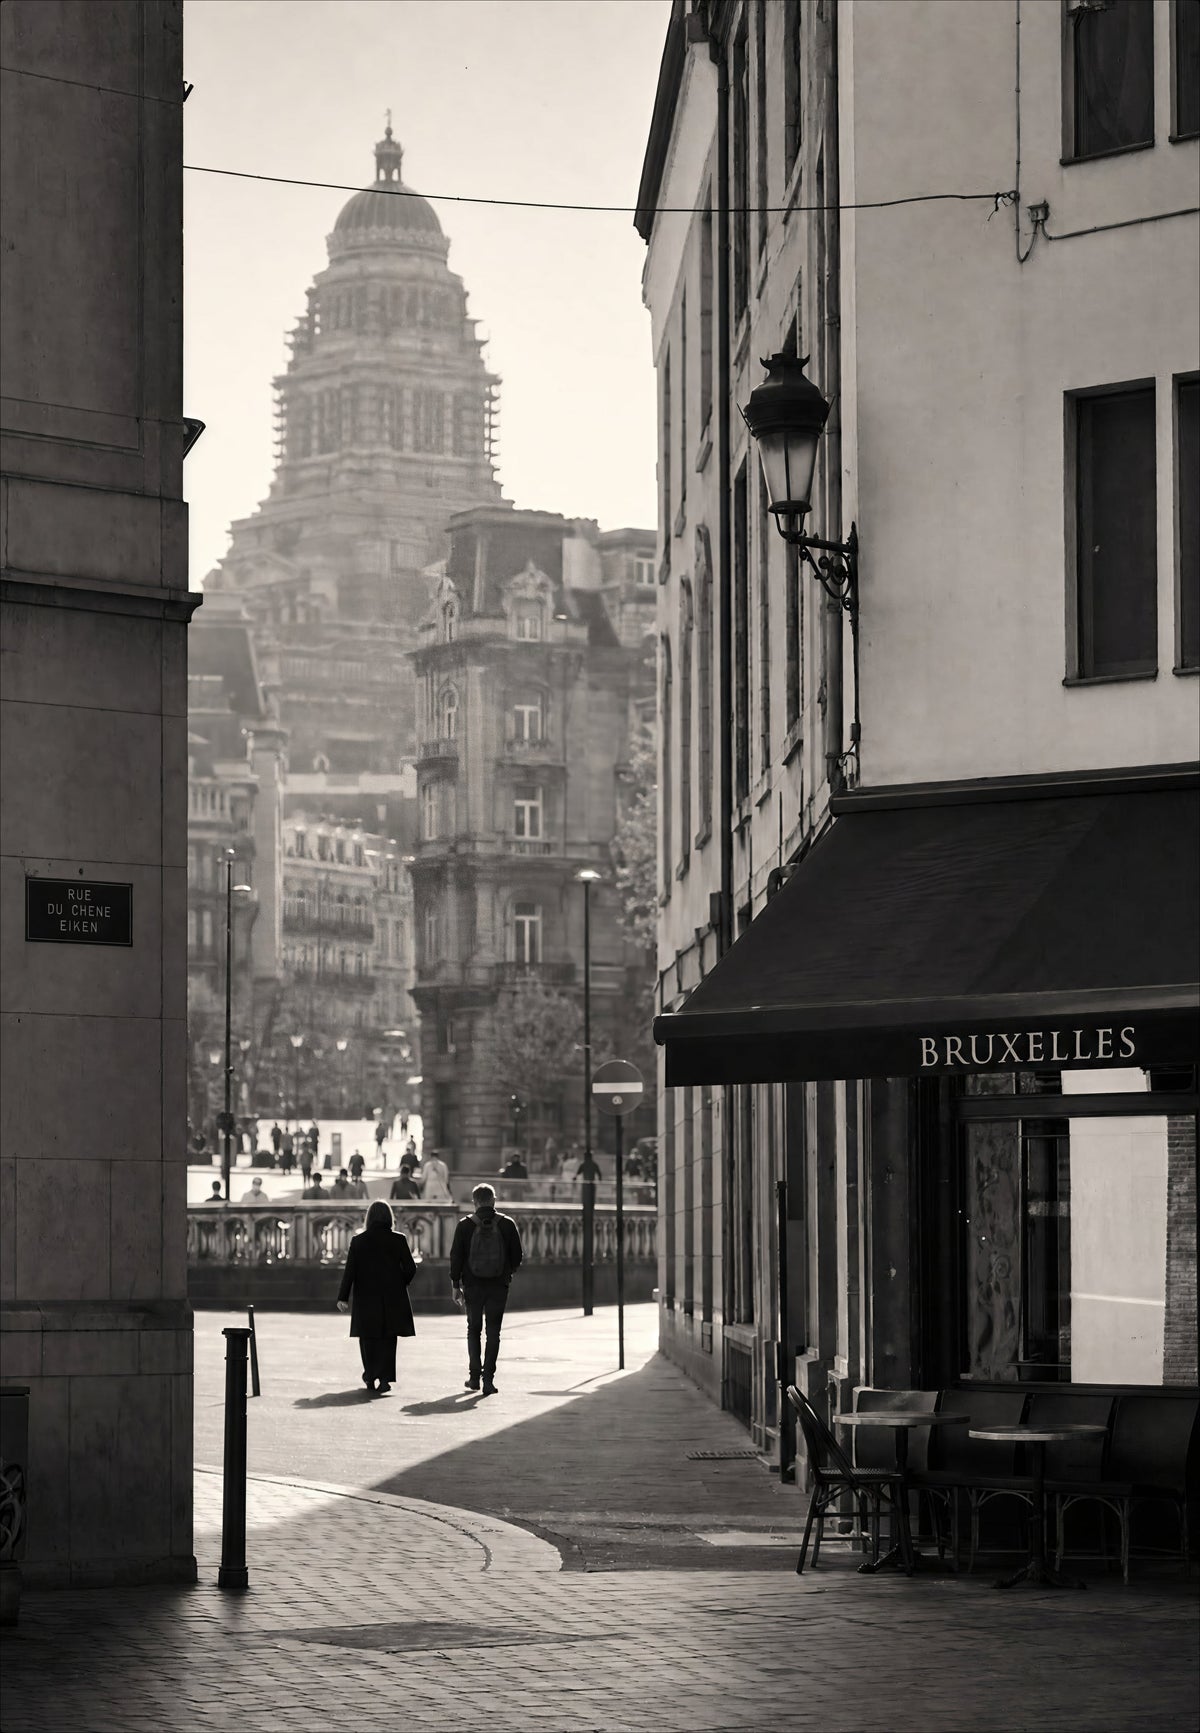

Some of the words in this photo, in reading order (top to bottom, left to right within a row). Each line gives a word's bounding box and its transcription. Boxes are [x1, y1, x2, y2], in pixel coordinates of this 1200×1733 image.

[68, 888, 92, 901] RUE
[47, 903, 63, 915] DU
[71, 904, 111, 918] CHENE
[60, 919, 98, 933] EIKEN
[919, 1026, 1136, 1067] BRUXELLES
